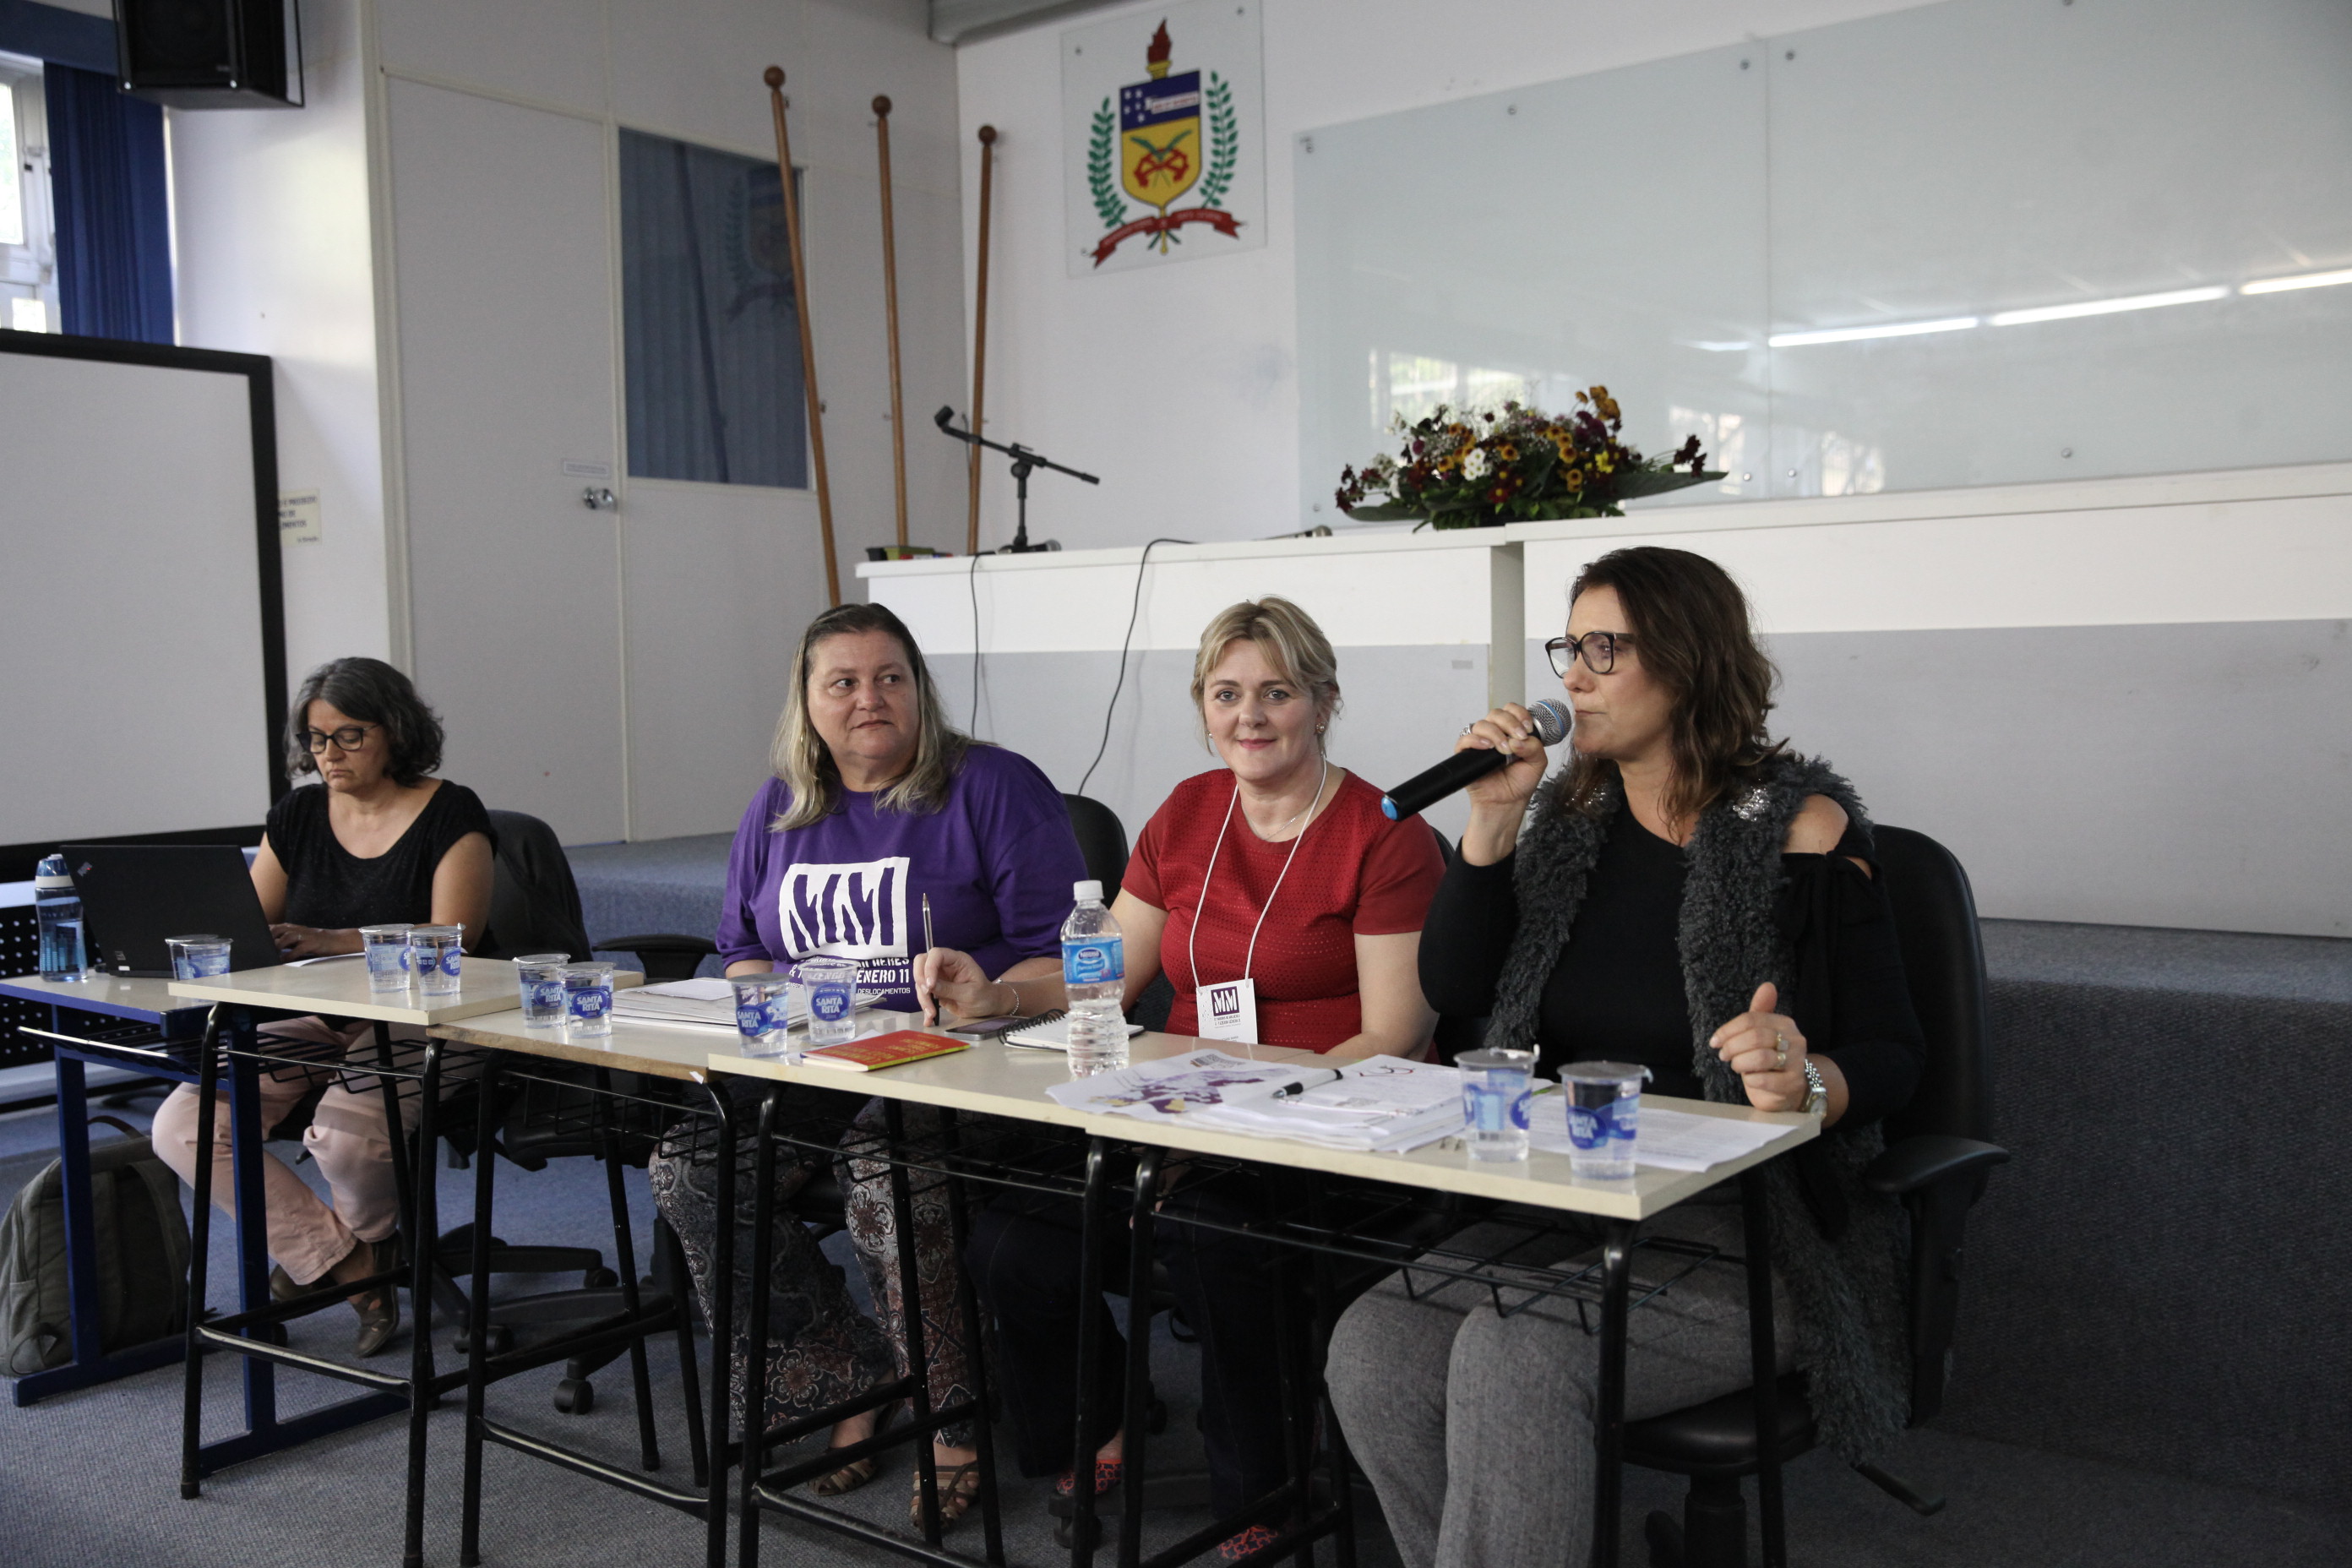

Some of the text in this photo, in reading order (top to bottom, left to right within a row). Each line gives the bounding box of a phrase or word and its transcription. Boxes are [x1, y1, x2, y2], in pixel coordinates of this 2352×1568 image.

[899, 968, 909, 983] 11
[576, 995, 602, 1004] SANTA
[815, 997, 843, 1006] SANTA
[1213, 988, 1238, 1014] MM
[582, 1002, 600, 1011] RITA
[821, 1004, 841, 1014] RITA
[737, 1011, 762, 1021] SANTA
[741, 1019, 759, 1028] RITA
